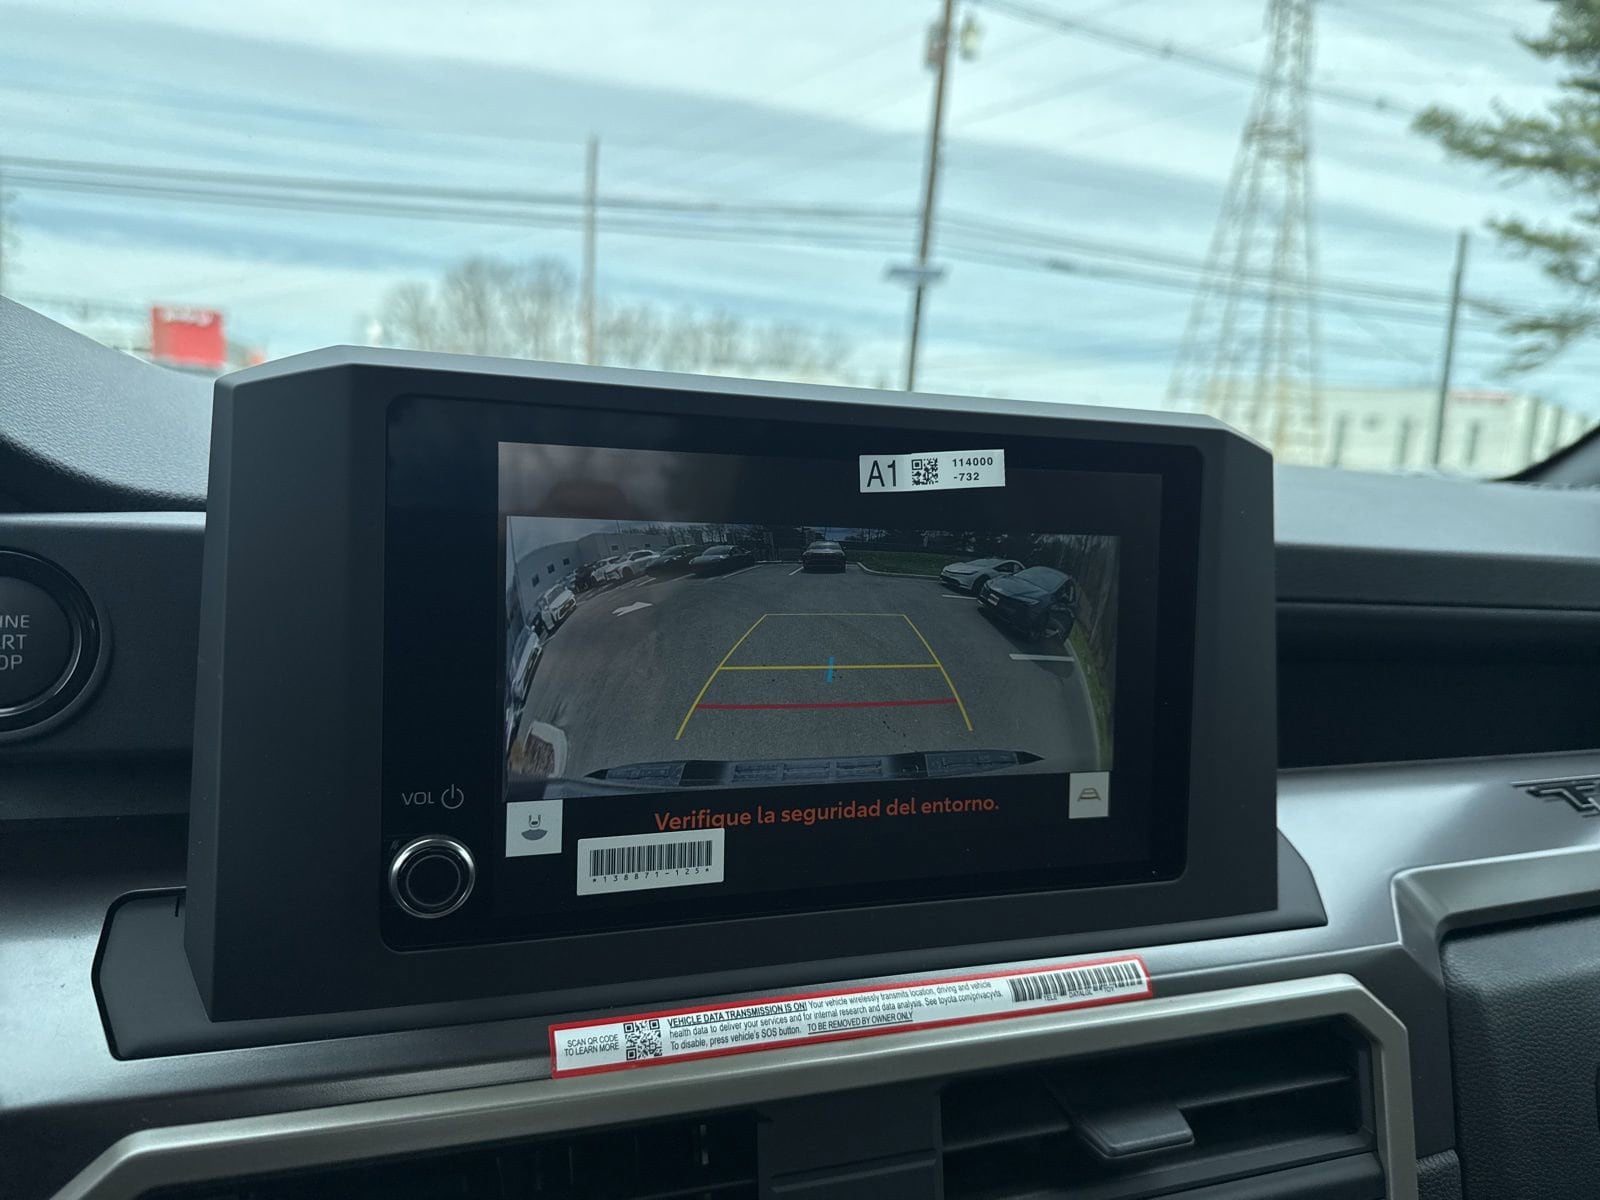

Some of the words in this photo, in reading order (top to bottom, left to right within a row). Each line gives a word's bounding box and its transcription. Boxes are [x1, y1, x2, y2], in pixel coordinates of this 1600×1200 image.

[952, 457, 994, 468] 114000
[866, 459, 896, 488] A1
[953, 472, 980, 482] -732
[0, 634, 27, 650] RT
[402, 792, 434, 806] VOL
[654, 808, 752, 831] Verifique
[758, 806, 776, 824] la
[780, 800, 881, 826] seguridad
[886, 797, 916, 816] del
[921, 798, 999, 814] entorno.
[668, 1016, 703, 1027] VEHICLE
[704, 1012, 724, 1023] DATA
[725, 1004, 783, 1020] TRANSMISSION
[785, 1004, 792, 1012] IS
[808, 1000, 823, 1008] Your
[825, 997, 848, 1006] vehicle
[850, 994, 880, 1004] wirelessly
[880, 990, 909, 1000] transmits
[937, 985, 957, 994] driving
[958, 982, 970, 990] and
[970, 980, 992, 990] vehicle
[670, 1027, 691, 1038] health
[693, 1025, 708, 1035] data
[710, 1024, 718, 1033] to
[720, 1022, 742, 1032] deliver
[744, 1020, 758, 1030] your
[760, 1016, 788, 1026] services
[790, 1014, 802, 1022] and
[802, 1012, 812, 1020] for
[814, 1009, 838, 1019] internal
[840, 1006, 867, 1016] research
[868, 1004, 880, 1012] and
[882, 1002, 896, 1011] data
[924, 998, 937, 1006] See
[671, 1041, 679, 1050] To
[710, 1036, 728, 1047] press
[730, 1031, 760, 1042] vehicle's
[762, 1028, 778, 1038] SOS
[808, 1023, 817, 1032] TO
[818, 1022, 827, 1030] BE
[828, 1018, 860, 1029] REMOVED
[862, 1016, 871, 1025] BY
[872, 1014, 896, 1024] OWNER
[896, 1011, 913, 1020] ONLY
[565, 1048, 574, 1056] TO
[576, 1045, 598, 1056] LEARN
[600, 1042, 620, 1052] MORE
[568, 1038, 586, 1048] SCAN
[588, 1036, 598, 1045] QR
[600, 1034, 618, 1043] CODE
